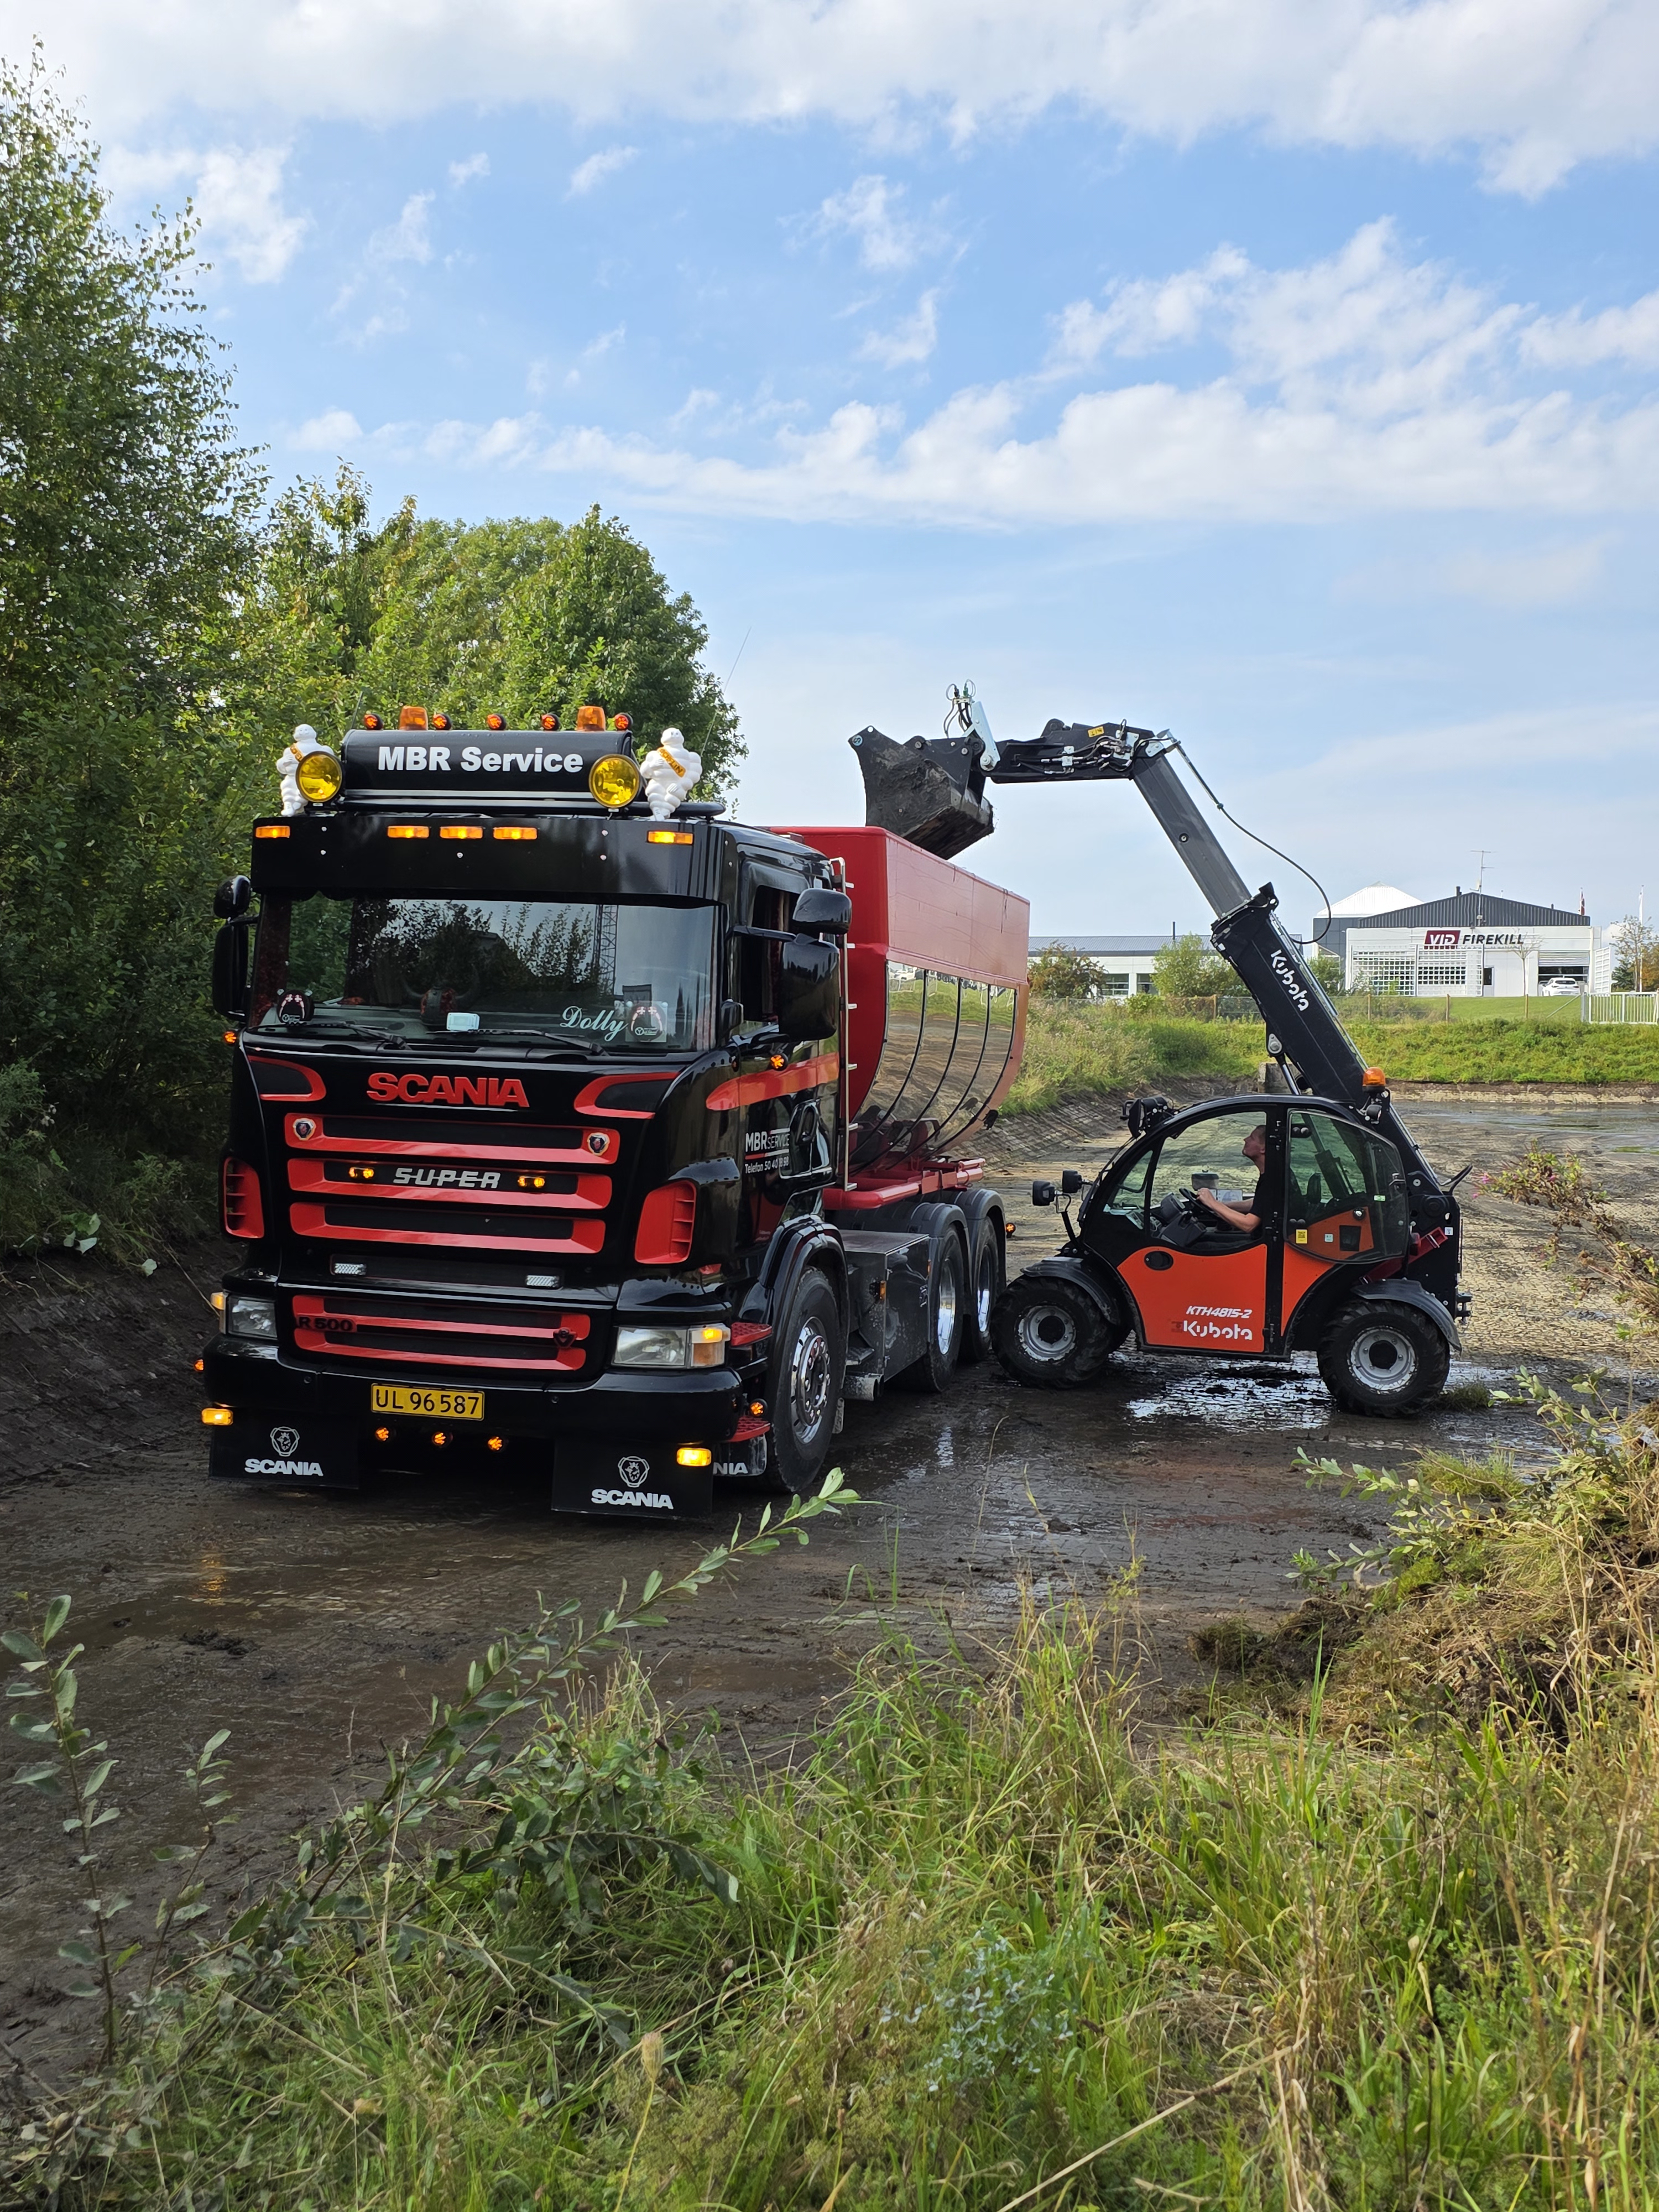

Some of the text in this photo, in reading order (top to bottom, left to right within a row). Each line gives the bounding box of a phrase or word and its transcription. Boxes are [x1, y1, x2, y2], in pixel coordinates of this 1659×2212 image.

[378, 746, 583, 773] MBR Service
[1463, 933, 1524, 945] FIREKILL
[1271, 949, 1309, 1011] Kubota
[560, 1005, 629, 1042] Dolly
[366, 1072, 530, 1107] SCANIA
[744, 1162, 763, 1173] Telefon
[393, 1167, 501, 1189] SUPER
[1186, 1306, 1253, 1319] KTH4815-2
[299, 1316, 353, 1331] R 500
[1183, 1320, 1253, 1340] Kubota
[376, 1389, 404, 1410] UL
[244, 1458, 324, 1477] SCANIA
[713, 1462, 749, 1475] NIA
[591, 1488, 674, 1510] SCANIA
